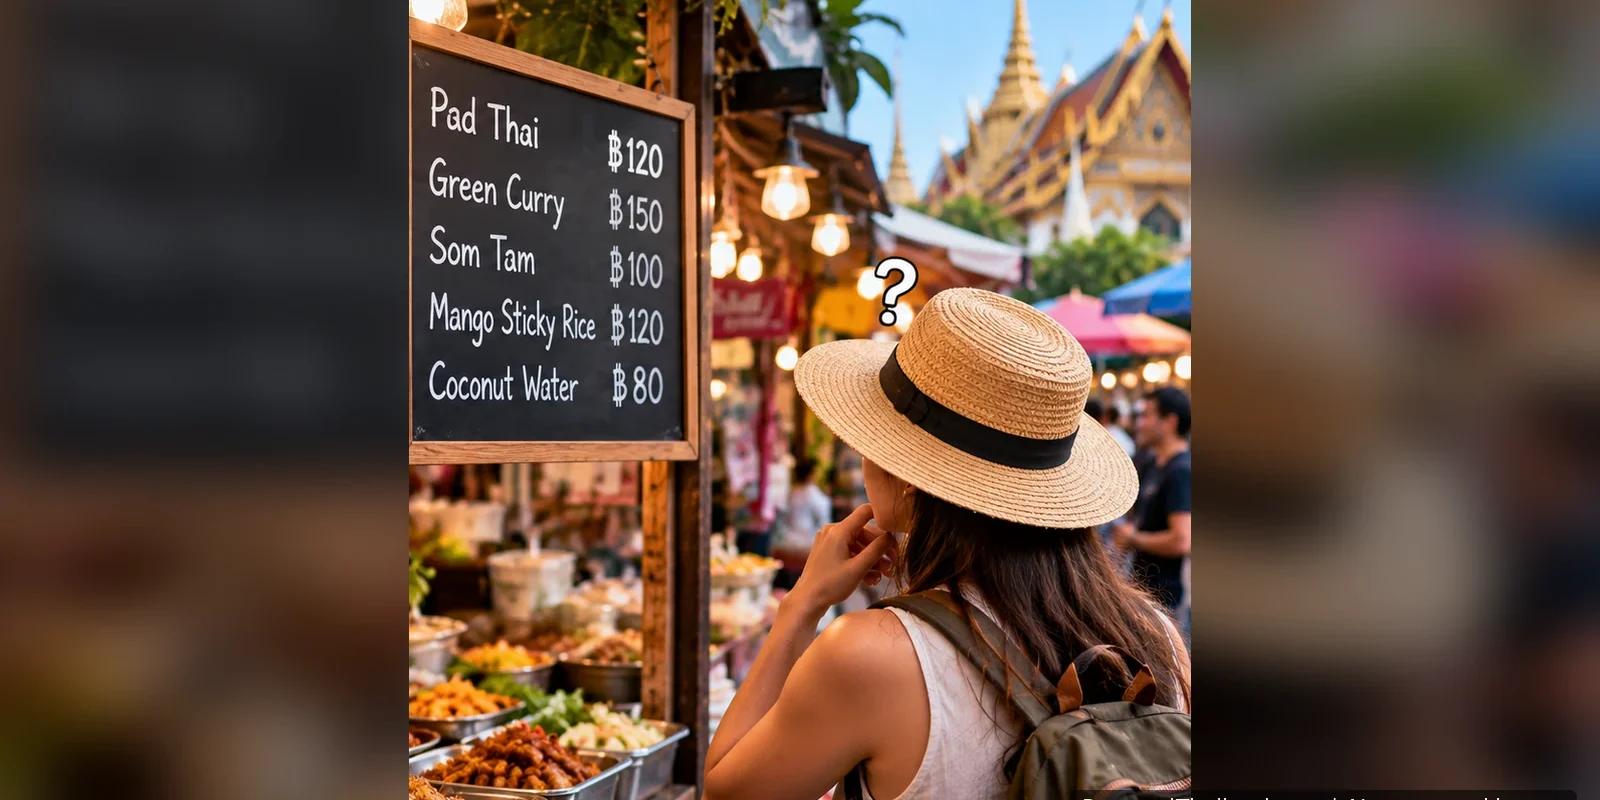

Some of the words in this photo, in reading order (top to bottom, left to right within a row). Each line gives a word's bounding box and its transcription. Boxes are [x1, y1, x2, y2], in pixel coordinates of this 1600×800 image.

[430, 86, 477, 136] Pad
[486, 102, 539, 150] Thai
[428, 156, 498, 206] Green
[506, 172, 565, 231] Curry
[429, 224, 481, 269] Som
[489, 233, 536, 276] Tam
[429, 291, 495, 348] Mango
[501, 297, 556, 351] Sticky
[562, 302, 597, 341] Rice
[428, 359, 514, 401] Coconut
[522, 364, 579, 402] Water
